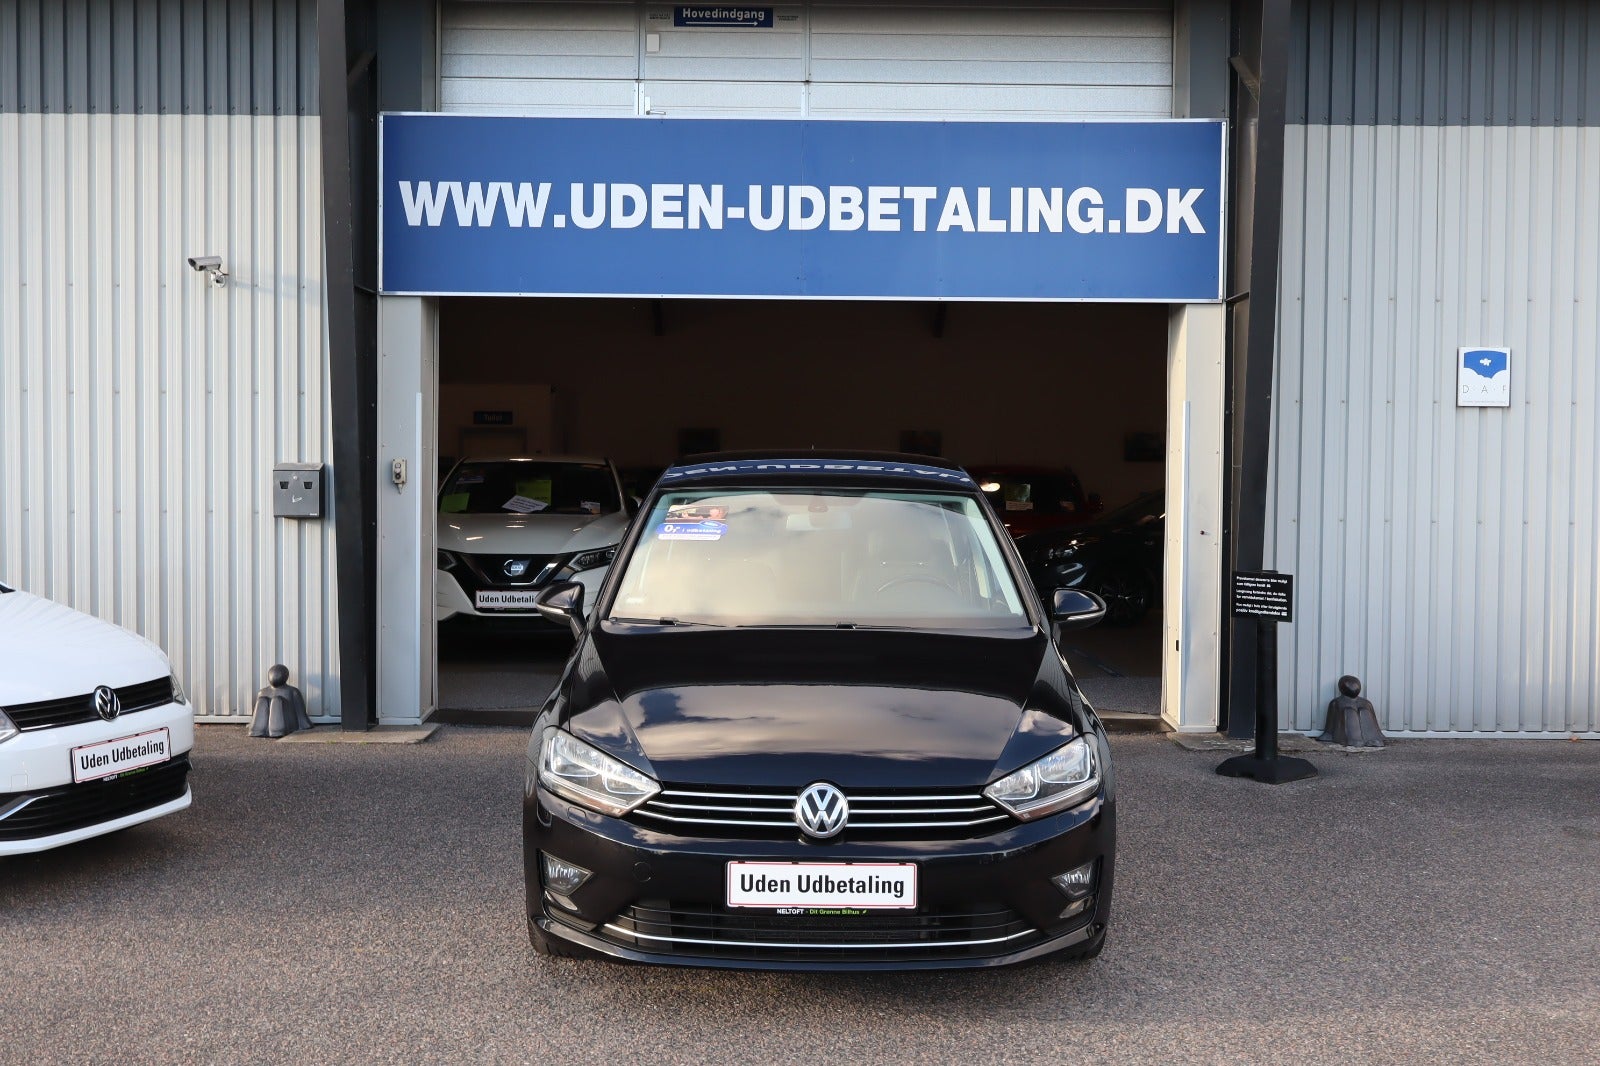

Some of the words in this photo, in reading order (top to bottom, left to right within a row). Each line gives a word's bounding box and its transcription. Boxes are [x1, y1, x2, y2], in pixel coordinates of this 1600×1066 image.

[682, 8, 765, 21] Hovedindgang
[398, 180, 1206, 235] WWW.UDEN-UDBETALING.DK
[479, 594, 499, 603] Uden
[501, 594, 534, 603] Udbetali
[81, 754, 109, 770] Uden
[112, 740, 164, 763] Udbetaling
[740, 873, 791, 893] Uden
[797, 874, 904, 898] Udbetaling
